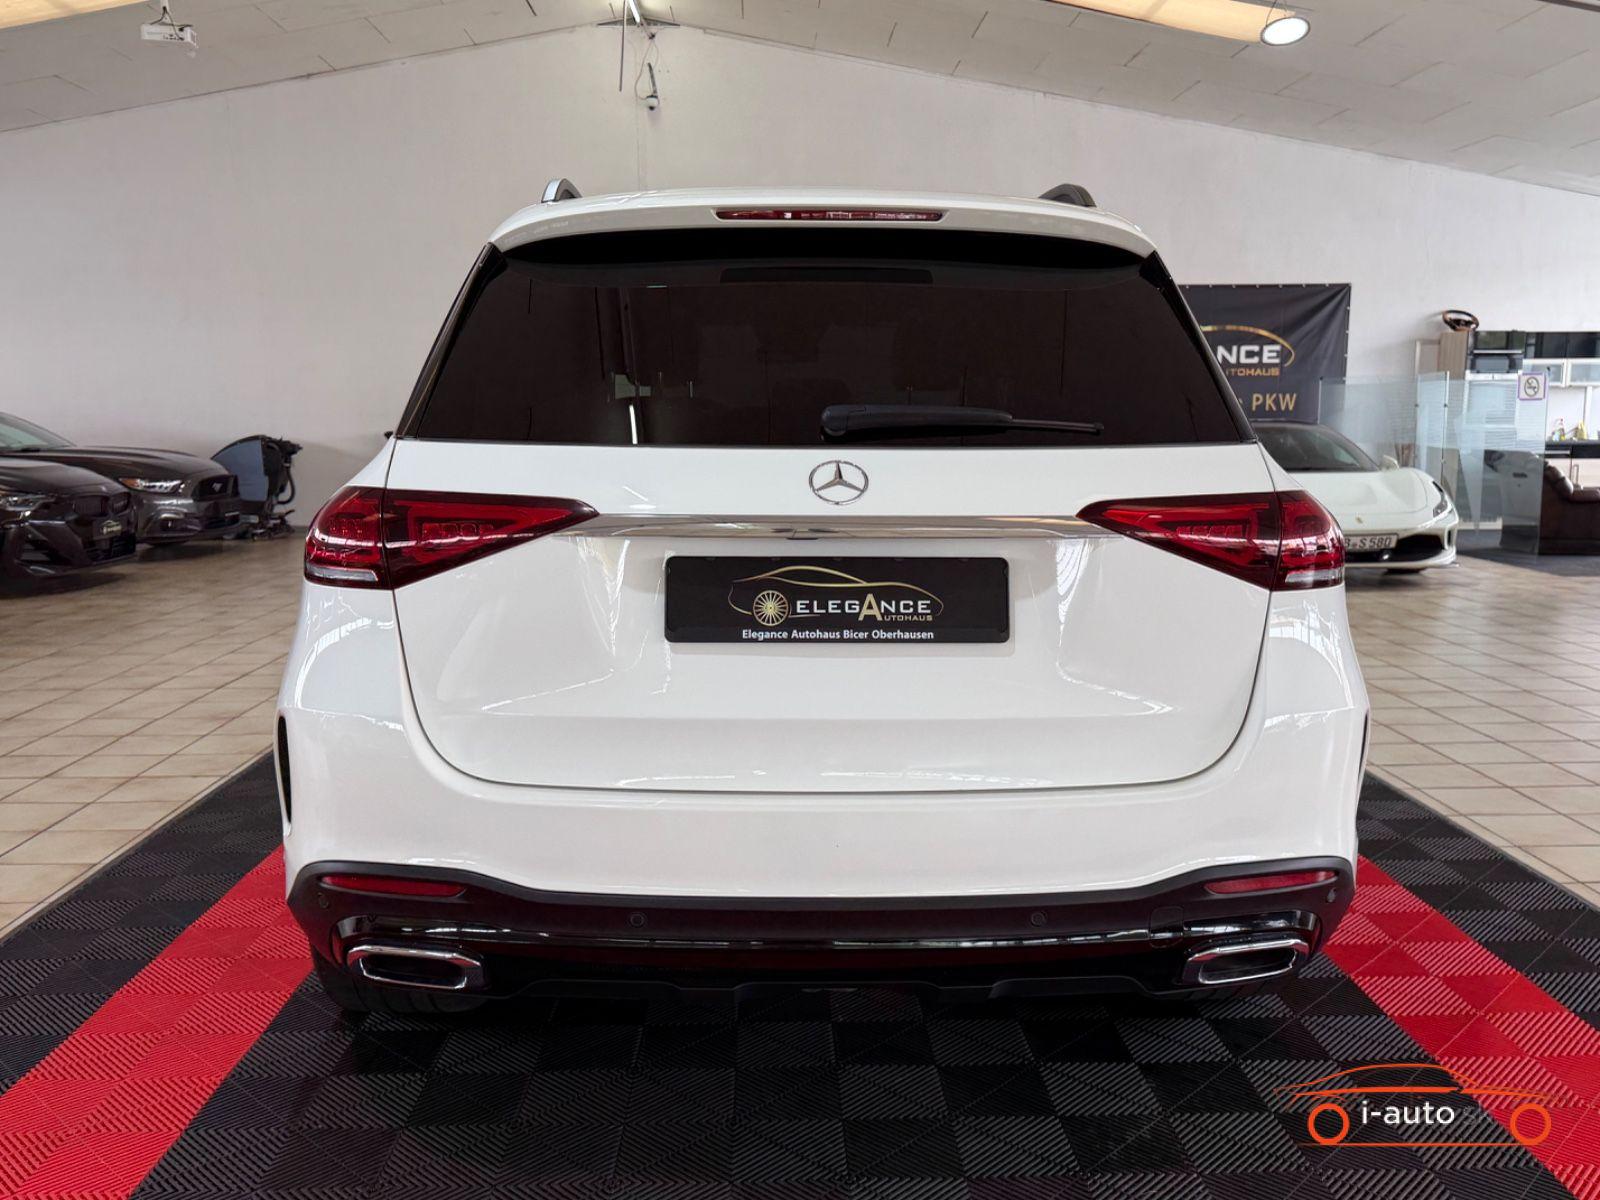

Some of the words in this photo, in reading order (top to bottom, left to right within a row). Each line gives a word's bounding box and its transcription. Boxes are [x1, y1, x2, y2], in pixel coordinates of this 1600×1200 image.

[1216, 345, 1282, 364] NCE
[1252, 393, 1297, 411] PKW
[796, 593, 931, 621] ELEGANCE
[742, 629, 788, 640] Elegance
[791, 629, 840, 639] Autohaus
[843, 629, 869, 639] Bicer
[872, 629, 934, 639] Oberhausen
